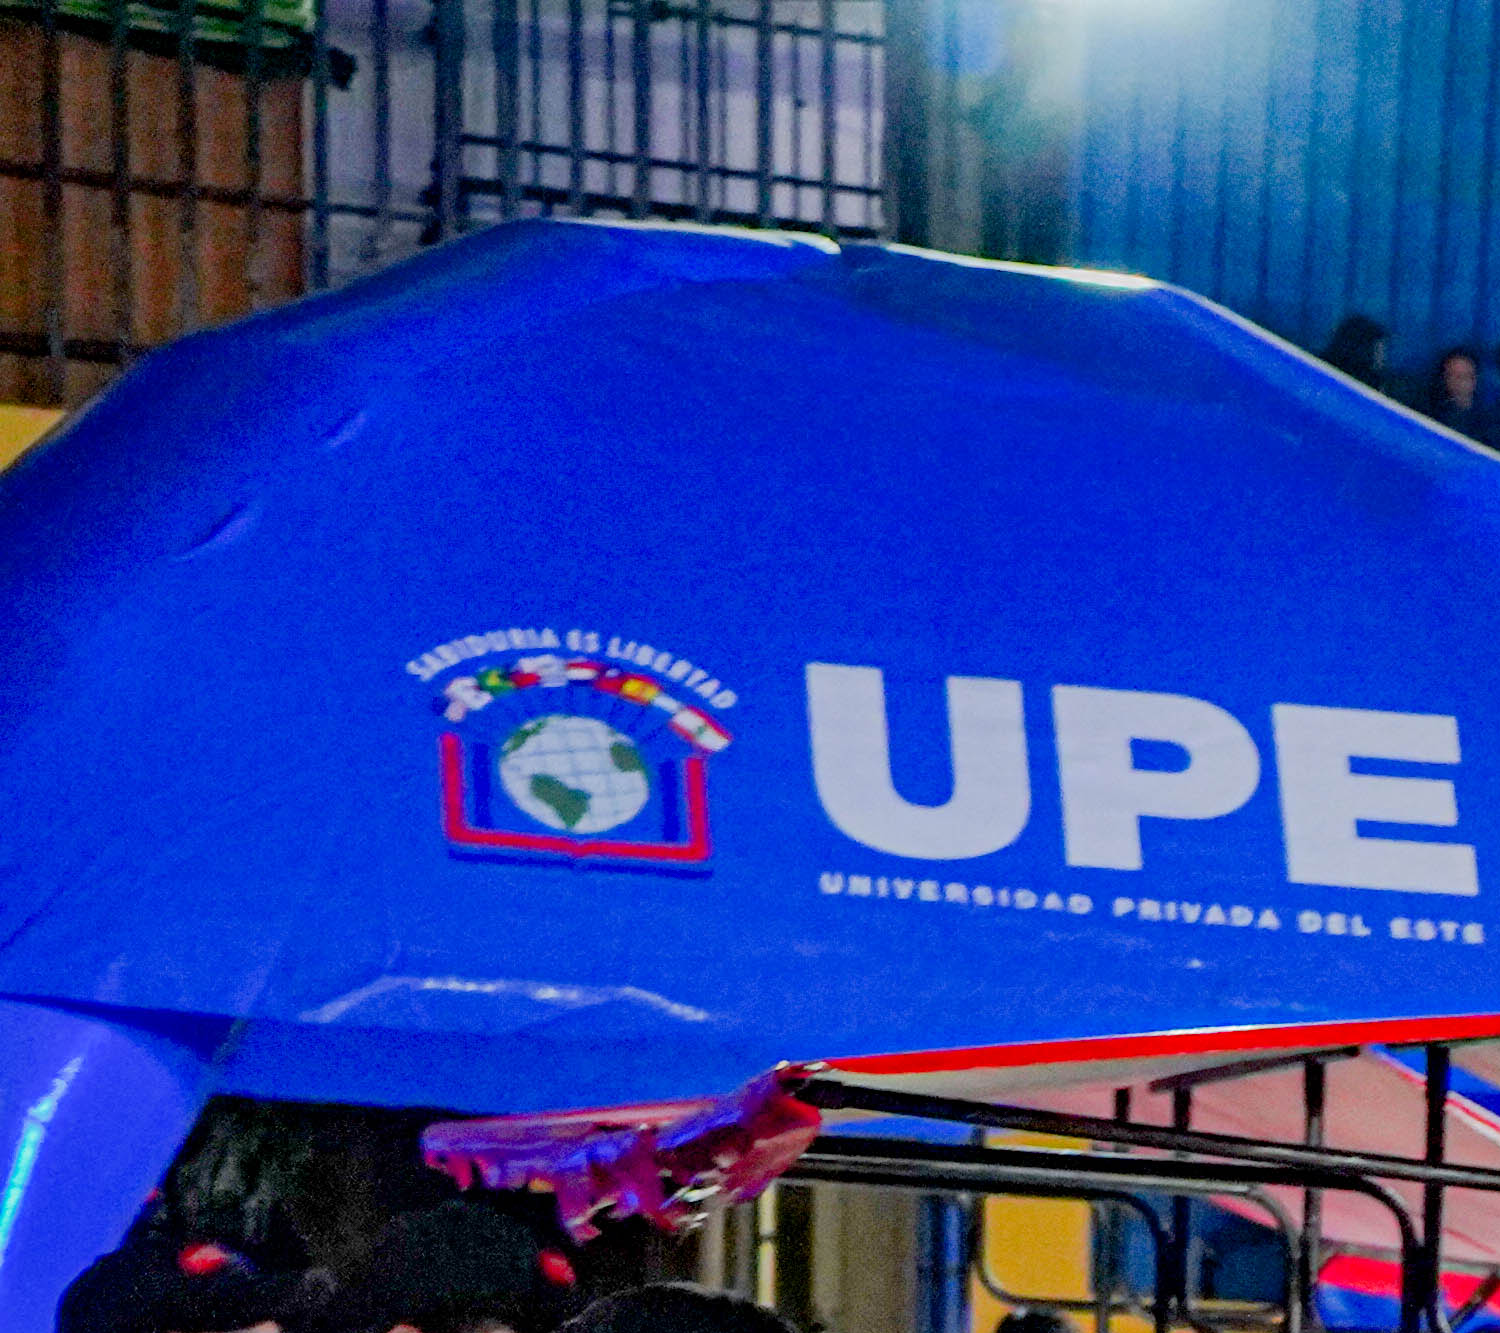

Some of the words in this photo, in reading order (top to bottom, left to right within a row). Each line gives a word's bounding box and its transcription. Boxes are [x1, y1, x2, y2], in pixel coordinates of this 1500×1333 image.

[605, 636, 738, 710] LIBERTAD
[804, 662, 1479, 896] UPE
[819, 872, 1094, 915] UNIVERSIDAD
[1112, 896, 1280, 931] PRIVADA
[1297, 909, 1372, 938] DEL
[1389, 916, 1486, 946] ESTE
